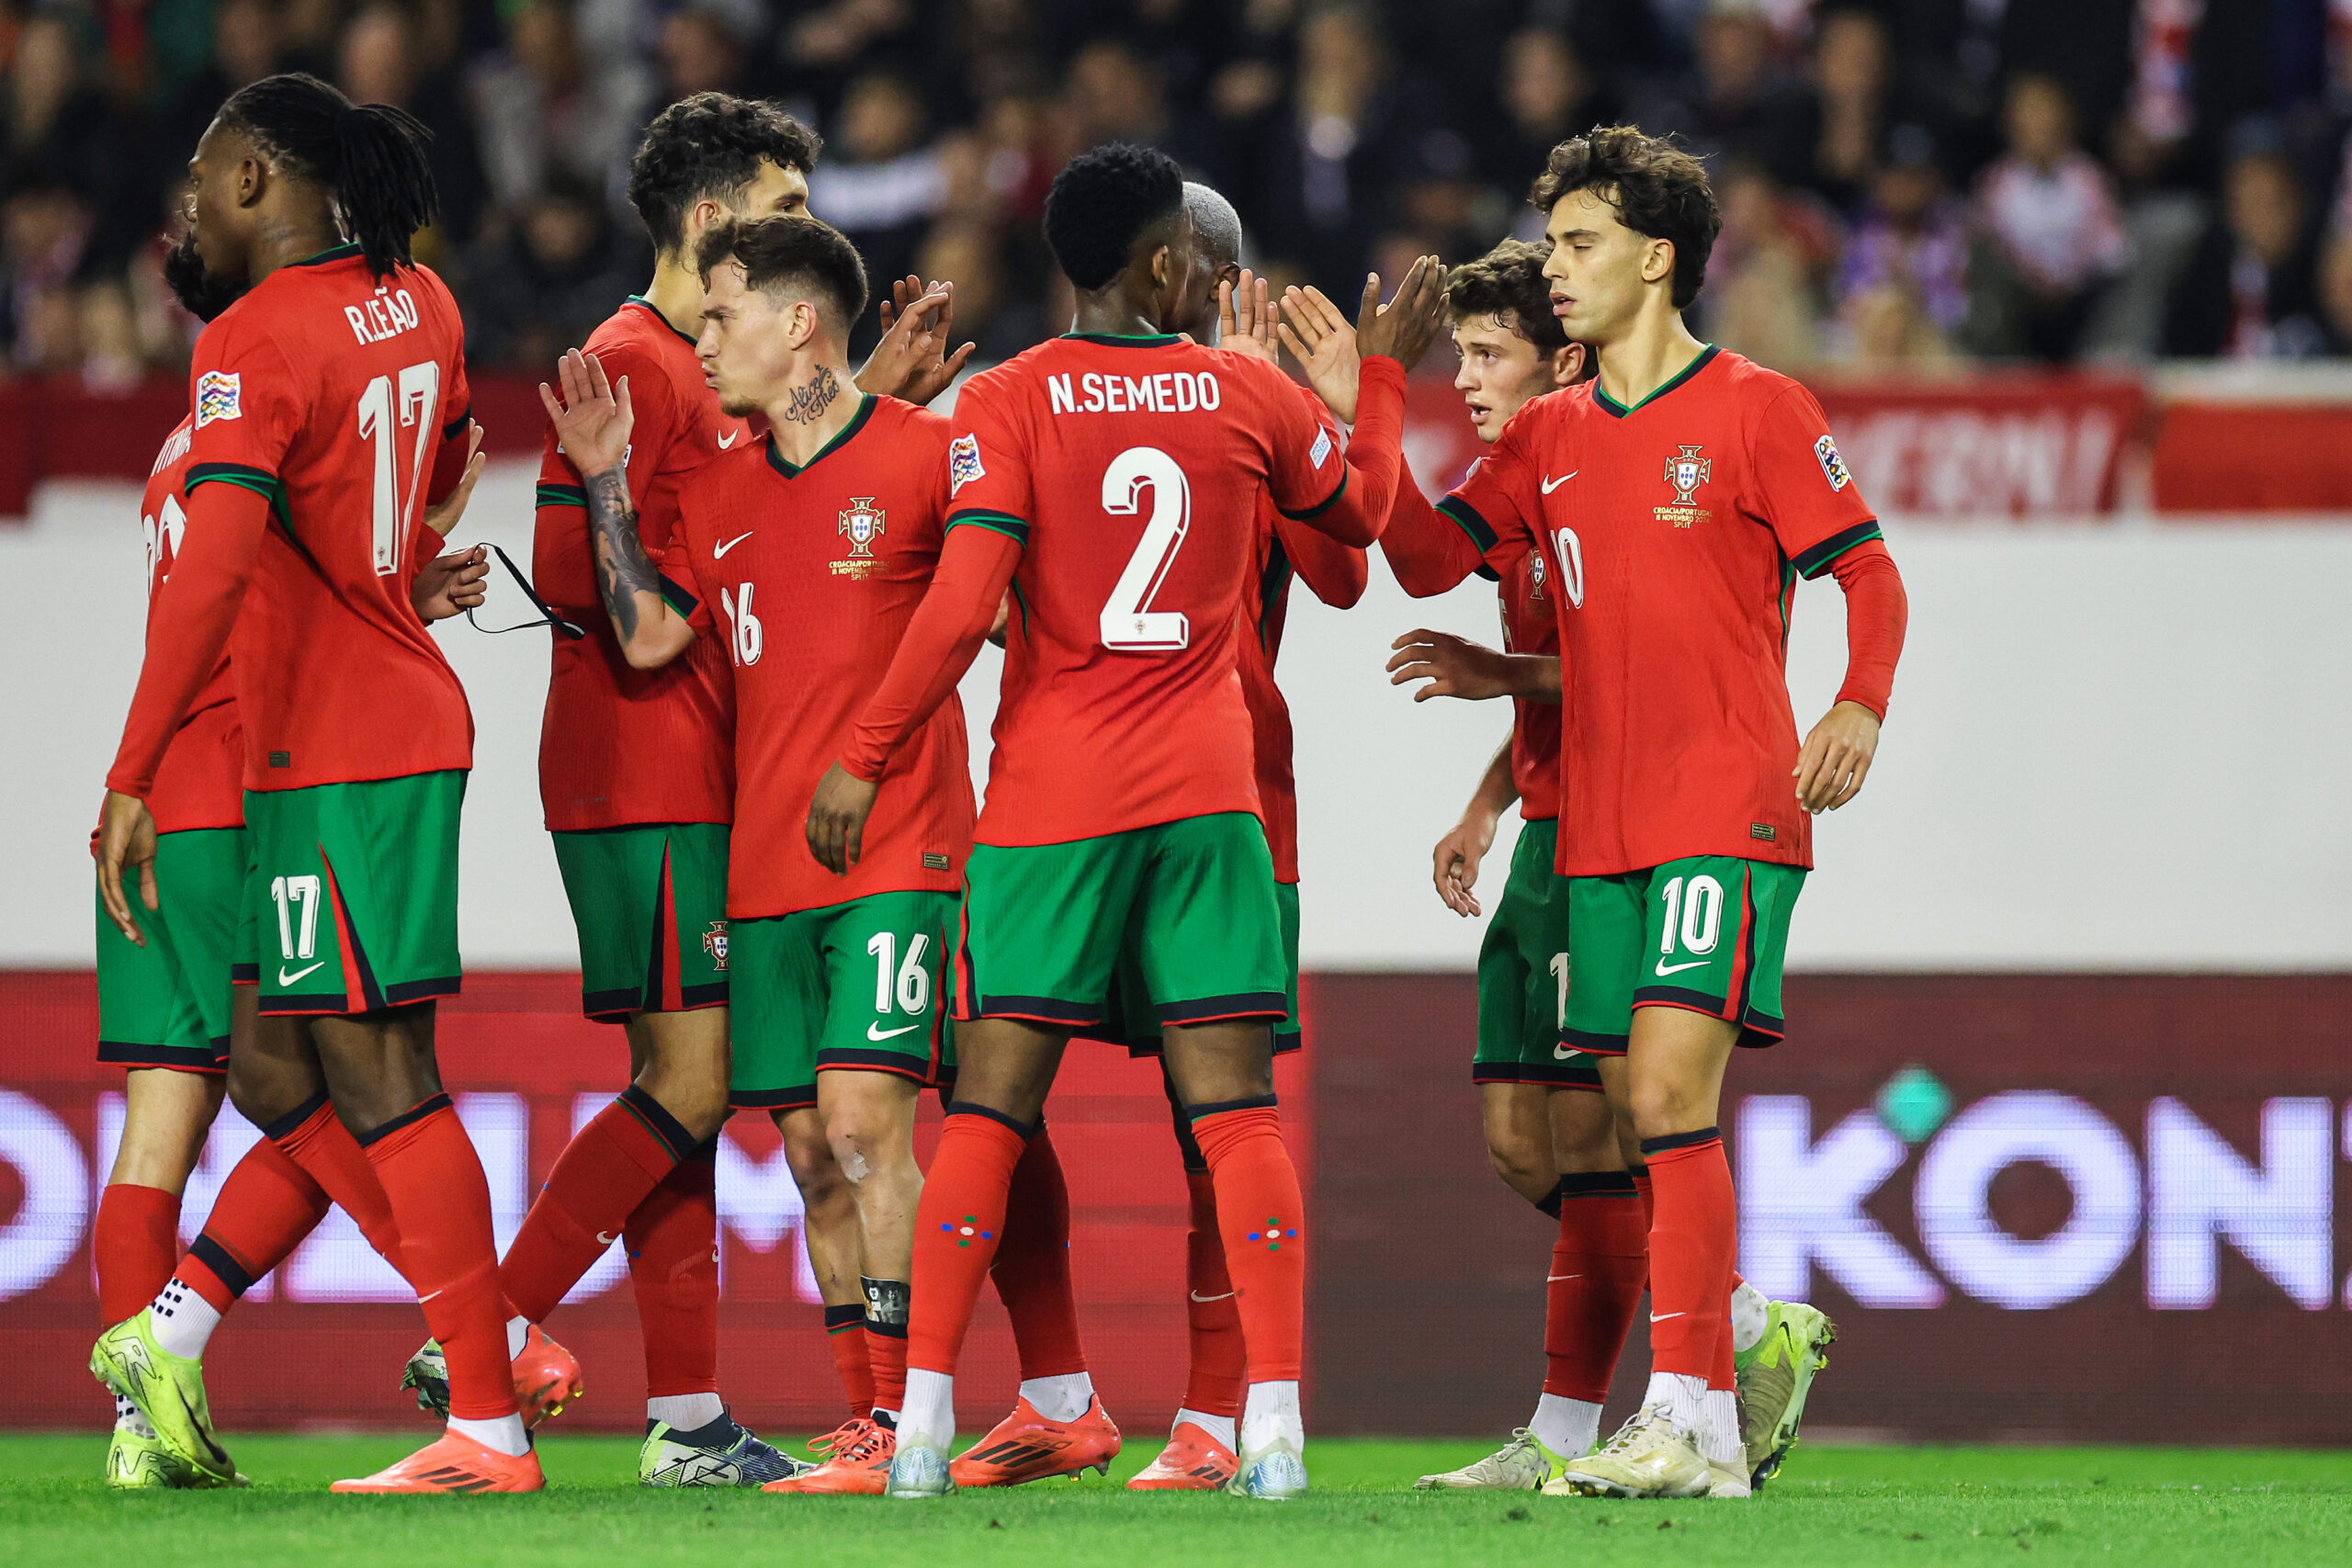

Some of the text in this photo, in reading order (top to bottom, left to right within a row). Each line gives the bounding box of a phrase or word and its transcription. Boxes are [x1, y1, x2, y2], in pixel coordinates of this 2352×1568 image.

[344, 286, 419, 345] R.LEÃO
[1047, 371, 1221, 414] N.SEMEDO
[357, 360, 440, 578] 17
[1100, 446, 1192, 650] 2
[1673, 521, 1691, 529] SPLIT
[720, 581, 763, 668] 16
[270, 874, 322, 960] 17
[1660, 874, 1724, 955] 10
[867, 931, 931, 1016] 16
[1734, 1089, 2352, 1312] KON
